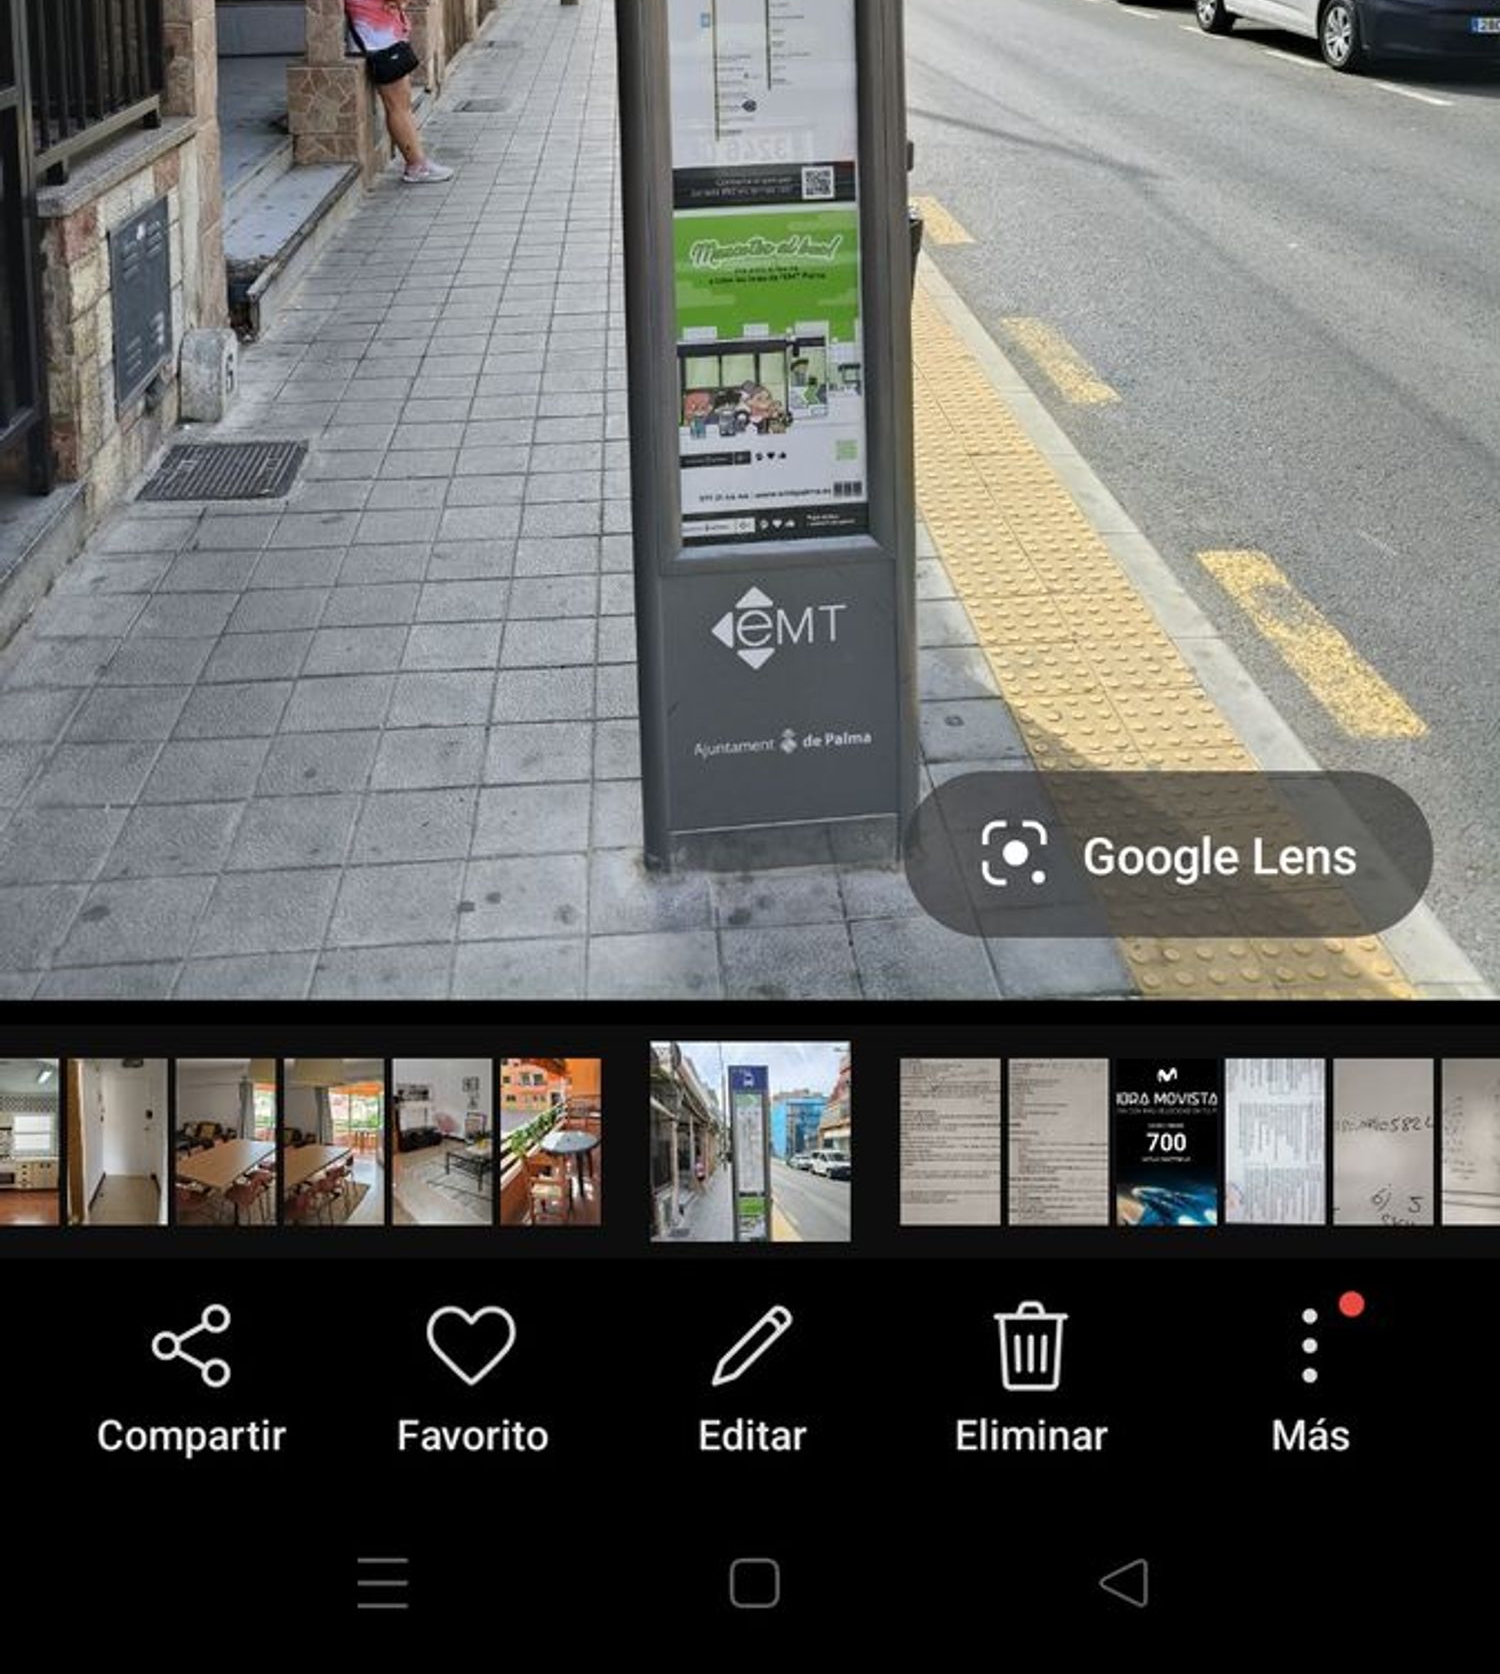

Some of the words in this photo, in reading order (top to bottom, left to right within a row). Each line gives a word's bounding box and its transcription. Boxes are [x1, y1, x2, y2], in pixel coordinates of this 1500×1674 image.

[694, 738, 775, 759] Ajuntament
[803, 734, 822, 748] de
[824, 731, 873, 746] Palma
[1145, 1132, 1187, 1153] 700
